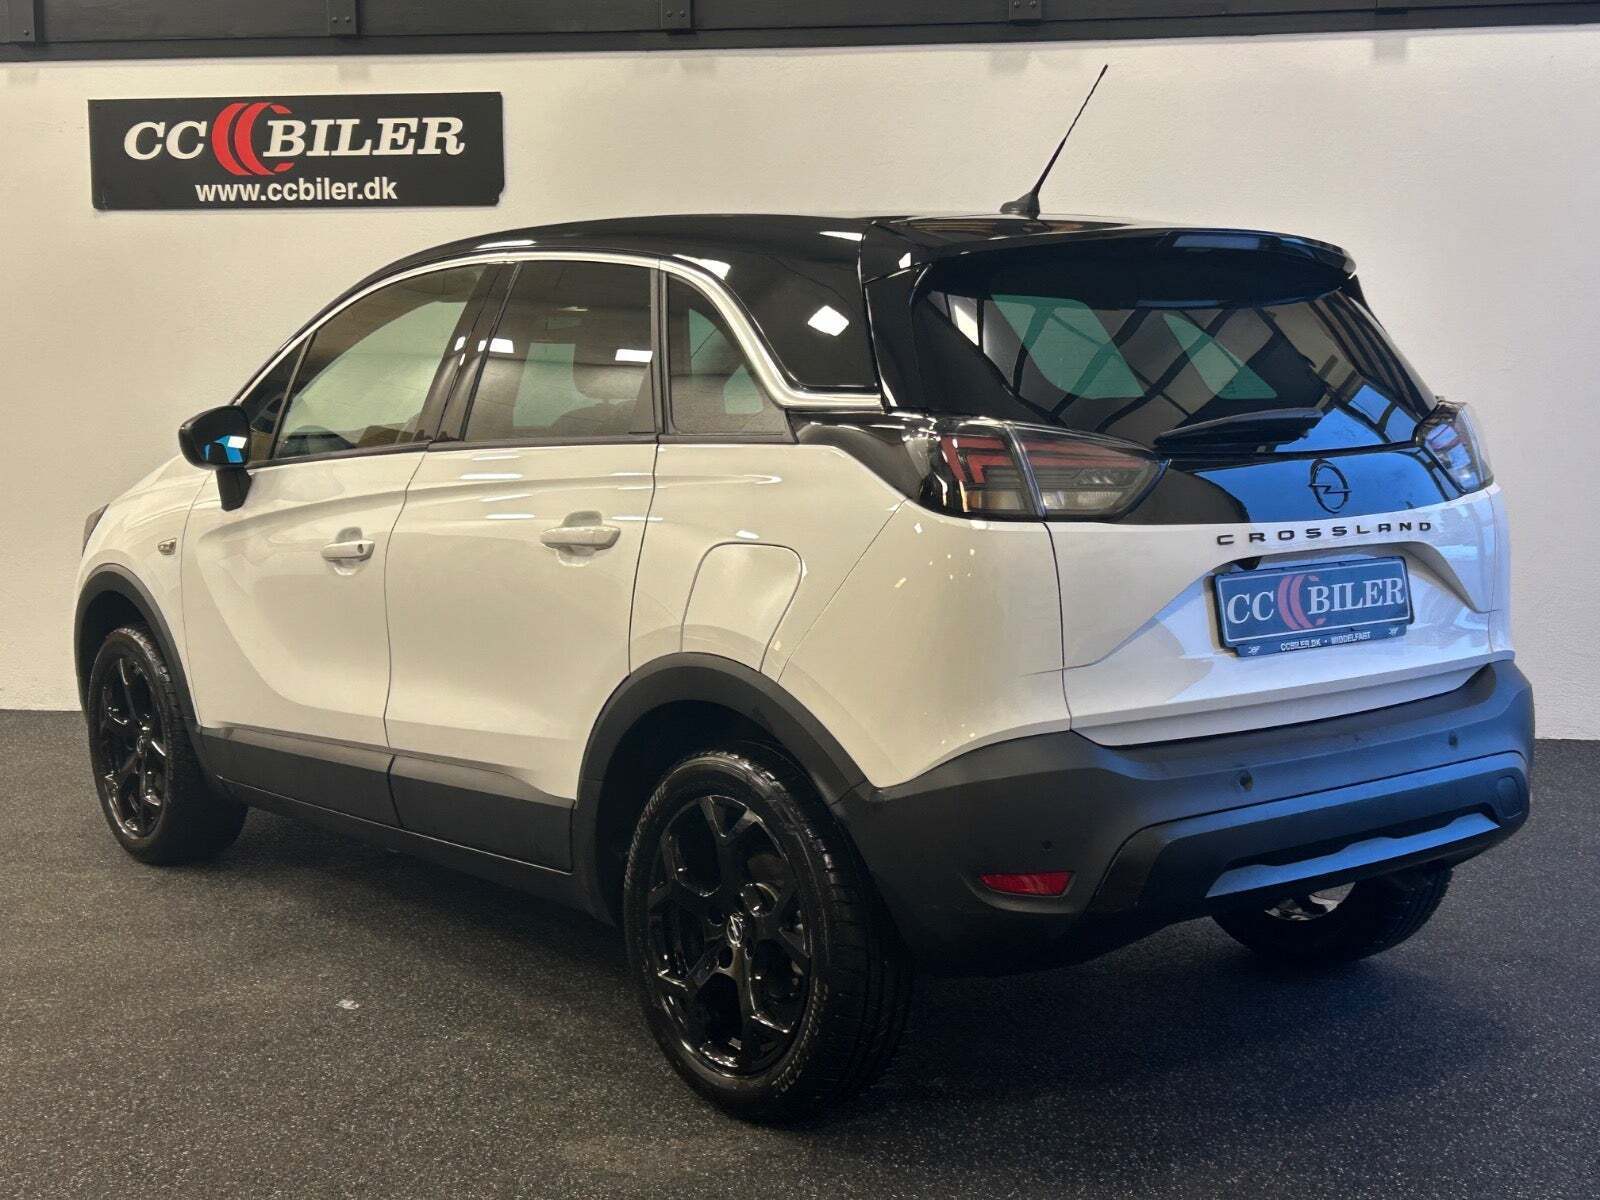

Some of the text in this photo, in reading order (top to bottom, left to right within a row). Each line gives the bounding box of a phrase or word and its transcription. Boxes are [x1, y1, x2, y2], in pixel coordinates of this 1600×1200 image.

[124, 116, 465, 161] CC BILER
[195, 176, 398, 202] www.ccbiler.dk
[1217, 521, 1432, 545] CROSSLAND
[1227, 577, 1404, 624] CC BILER
